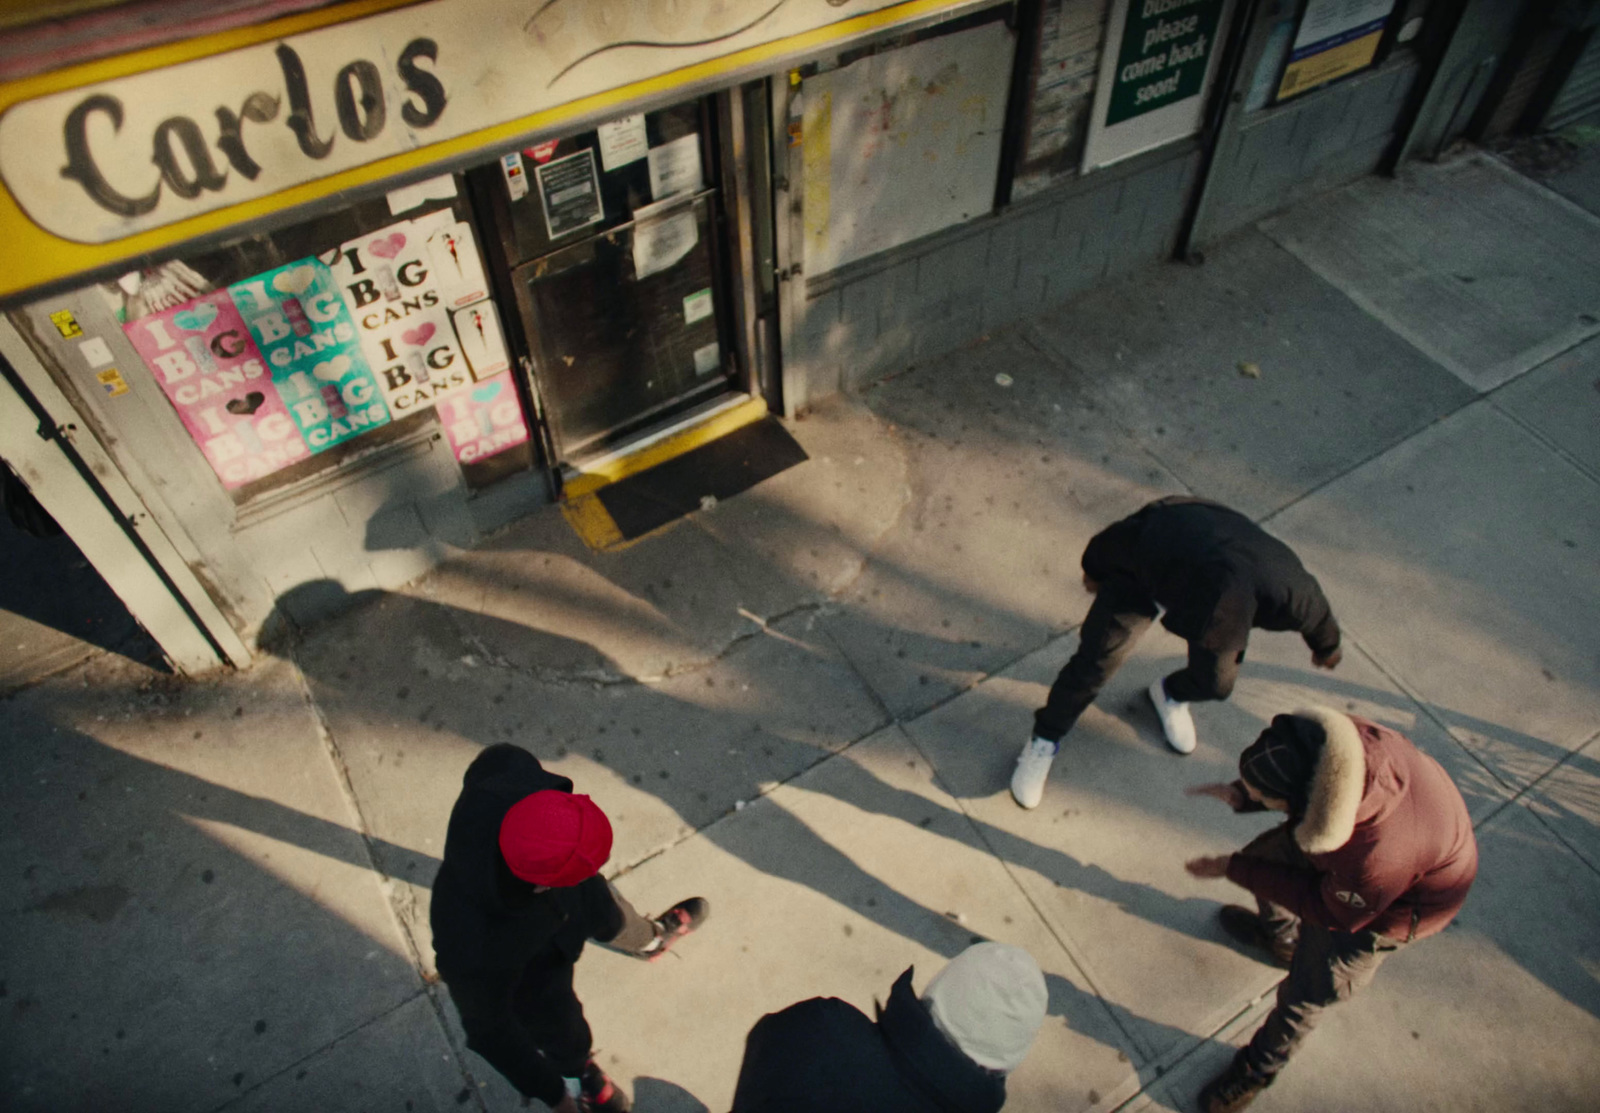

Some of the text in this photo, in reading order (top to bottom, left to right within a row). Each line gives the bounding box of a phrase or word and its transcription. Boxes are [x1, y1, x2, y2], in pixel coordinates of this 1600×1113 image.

[1143, 14, 1199, 54] please
[1121, 33, 1207, 82] come back
[1134, 68, 1181, 106] soon!
[60, 36, 449, 217] Carlos
[343, 247, 367, 275] I
[245, 280, 275, 311] I
[362, 290, 439, 330] CANS
[145, 319, 177, 350] I
[270, 321, 353, 367] CANS
[379, 338, 399, 361] I
[175, 358, 264, 404] CANS
[289, 371, 317, 398] I
[394, 371, 465, 409] CANS
[200, 406, 228, 434] I
[308, 403, 386, 447] CANS
[448, 396, 469, 420] I
[224, 437, 306, 482] CANS
[459, 424, 527, 462] CANS
